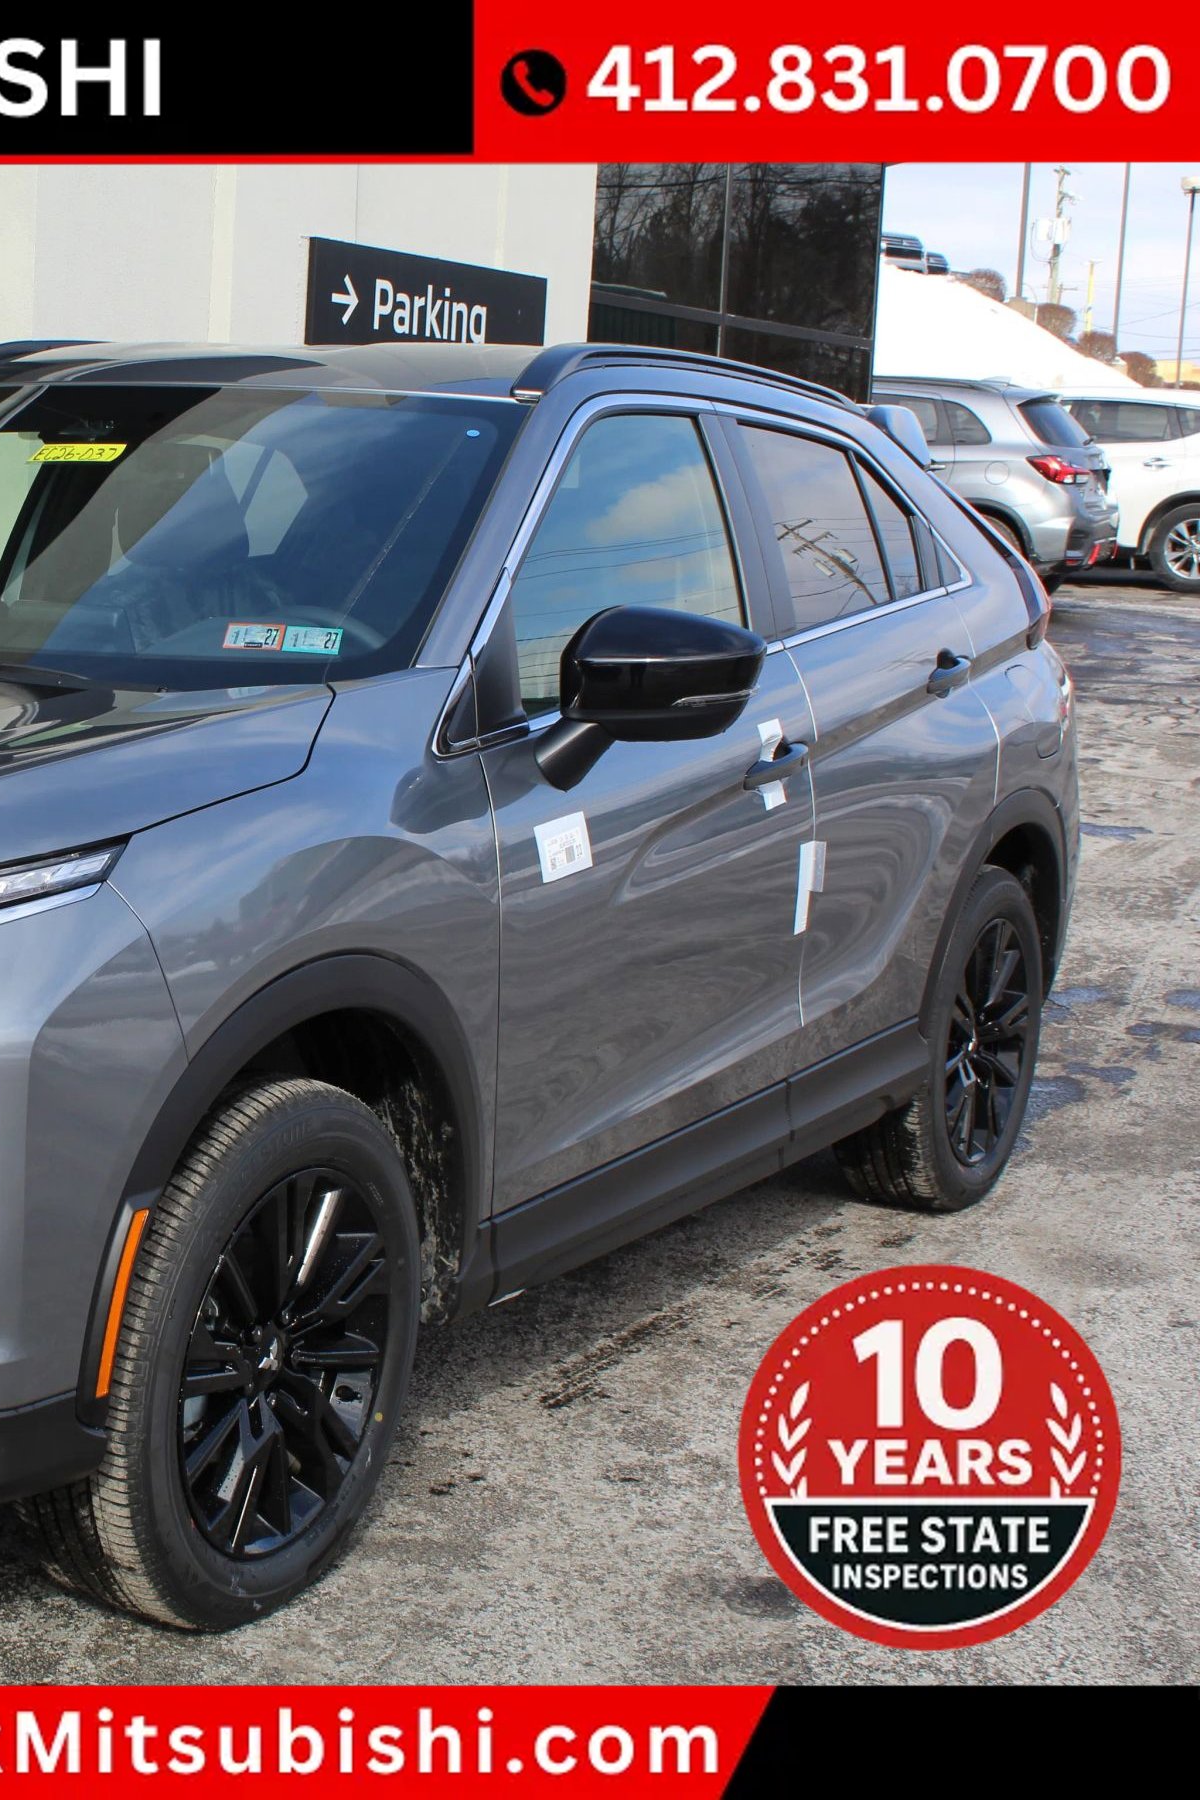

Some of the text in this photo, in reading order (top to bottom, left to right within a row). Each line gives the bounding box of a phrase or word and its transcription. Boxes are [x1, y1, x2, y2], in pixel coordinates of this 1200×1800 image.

[373, 279, 487, 344] Parking
[264, 629, 279, 646] 27
[324, 632, 338, 649] 27
